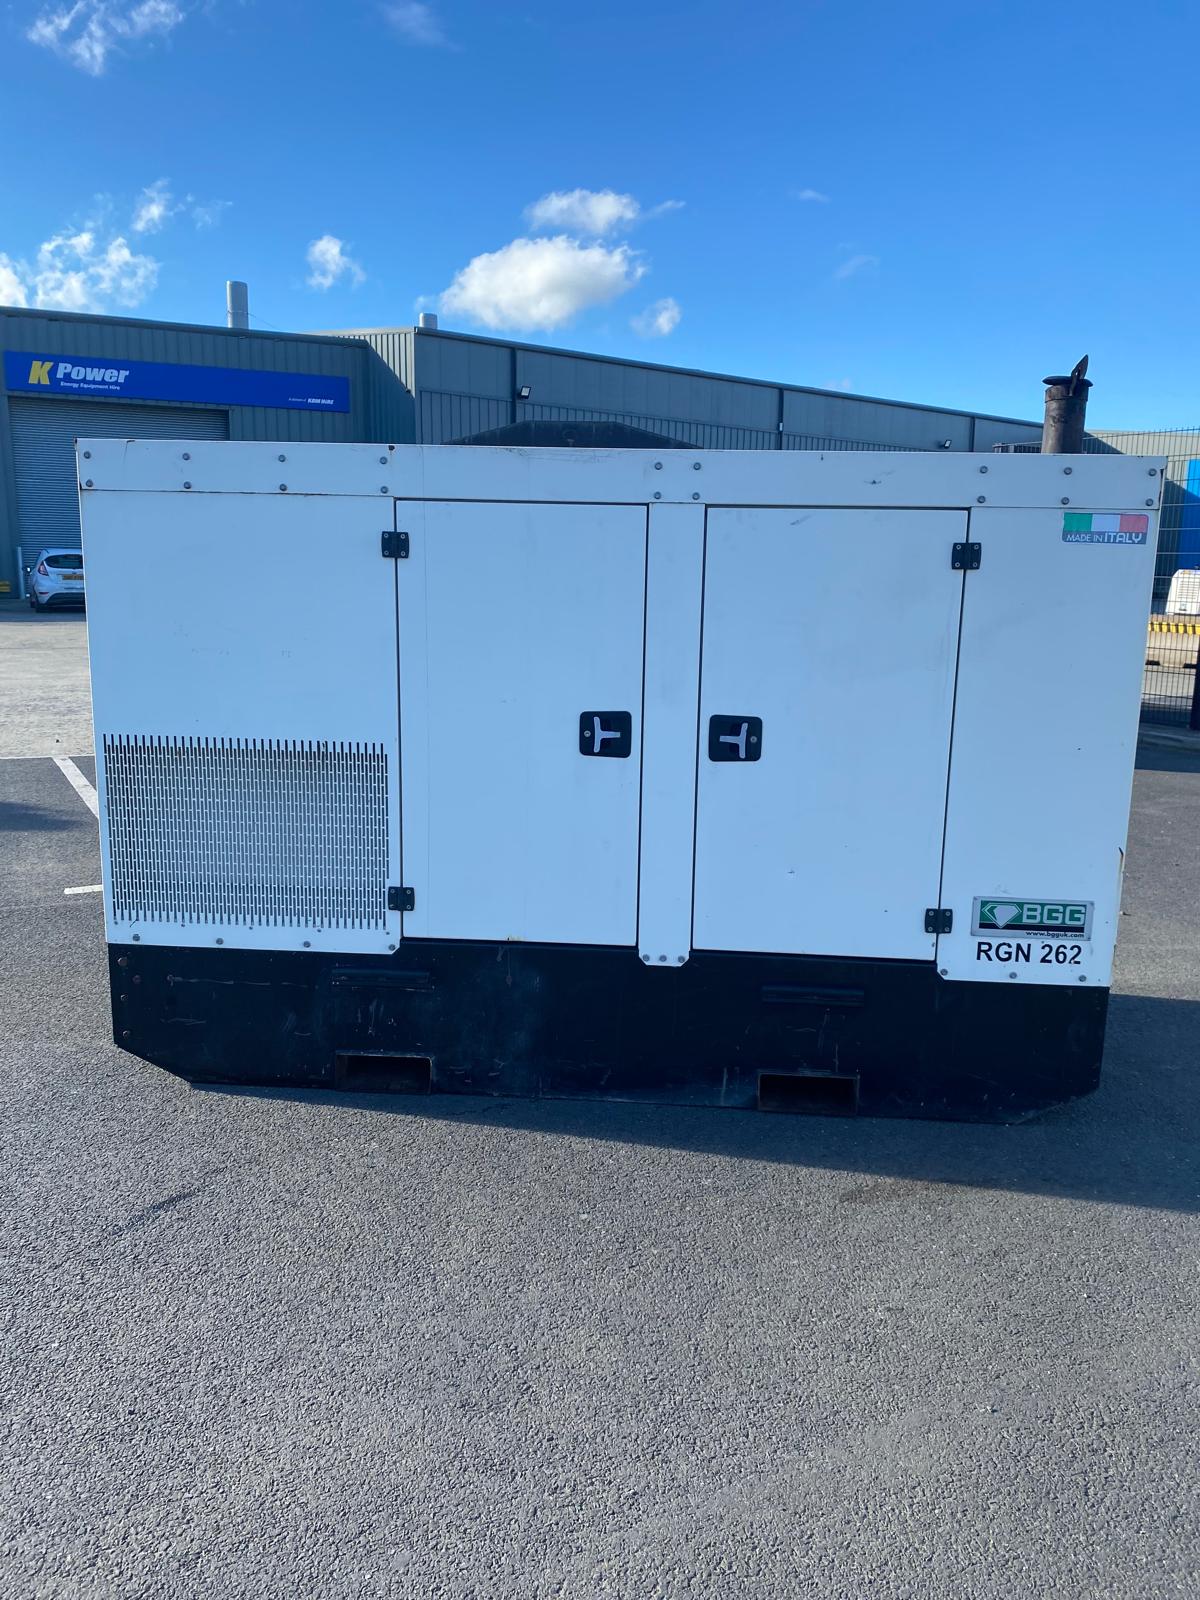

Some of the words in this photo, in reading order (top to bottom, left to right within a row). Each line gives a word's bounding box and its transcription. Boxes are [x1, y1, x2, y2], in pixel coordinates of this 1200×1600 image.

[28, 360, 54, 385] K
[56, 362, 130, 383] Power
[60, 381, 80, 389] Energy
[80, 382, 109, 390] Equipment
[1066, 533, 1092, 542] MADE
[1093, 534, 1103, 542] IN
[1104, 532, 1142, 544] ITALY
[1022, 903, 1086, 925] BGG
[1025, 931, 1085, 939] www.bgguk.com
[976, 941, 1032, 963] RGN
[1039, 943, 1082, 965] 262
